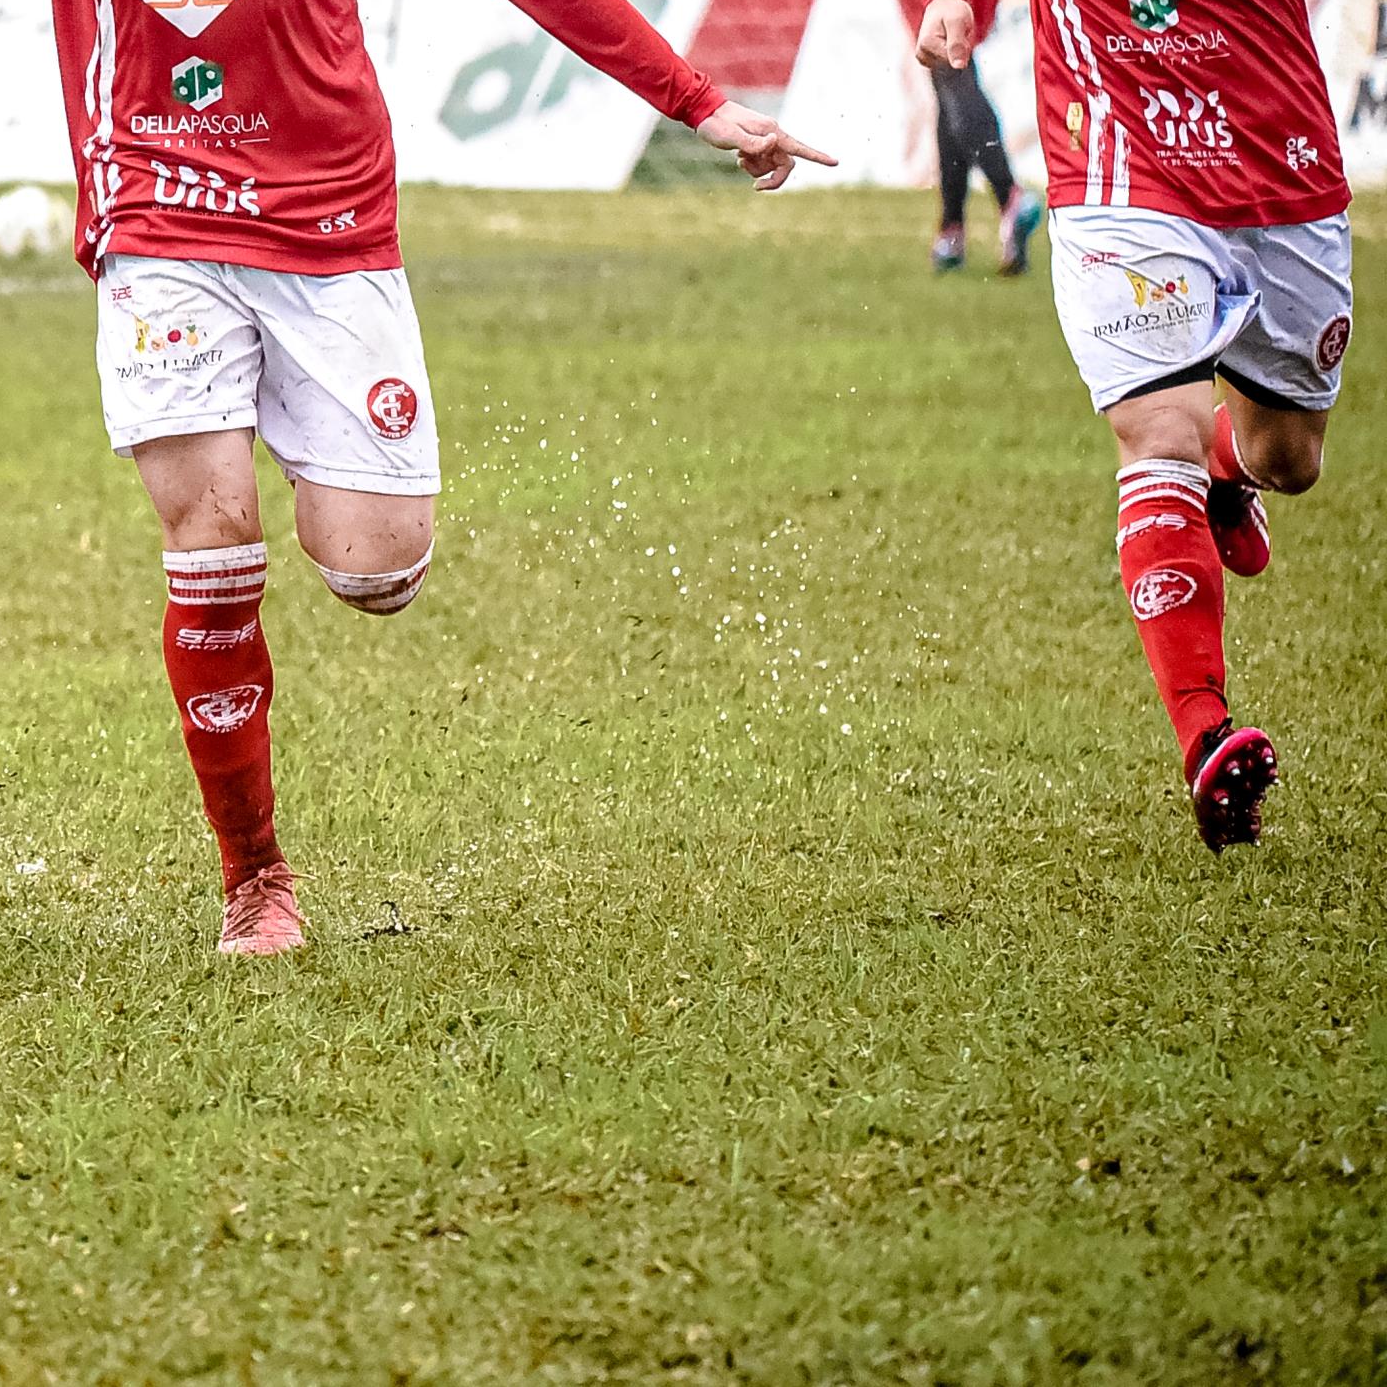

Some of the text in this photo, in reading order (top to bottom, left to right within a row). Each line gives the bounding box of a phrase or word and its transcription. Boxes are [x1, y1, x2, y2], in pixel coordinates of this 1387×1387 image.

[131, 112, 270, 135] DELLAPASQUA
[164, 138, 237, 149] BRITAS
[1093, 312, 1160, 338] IRMÃOS
